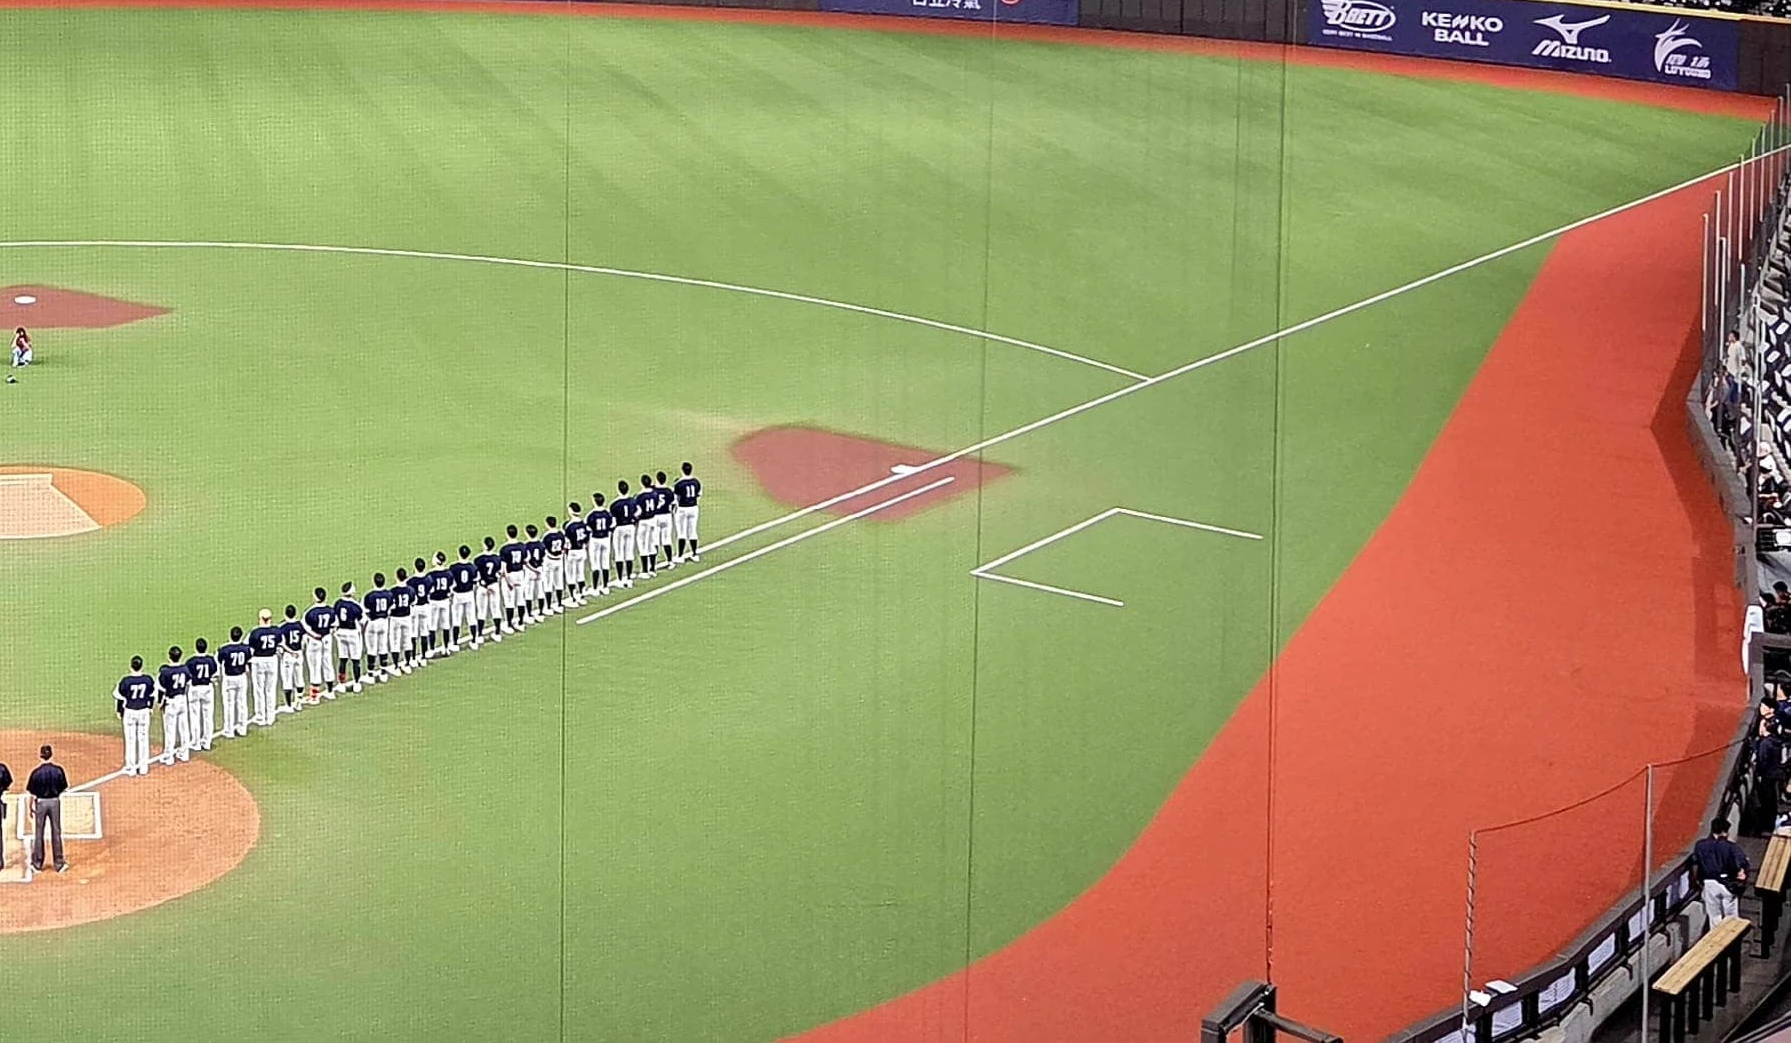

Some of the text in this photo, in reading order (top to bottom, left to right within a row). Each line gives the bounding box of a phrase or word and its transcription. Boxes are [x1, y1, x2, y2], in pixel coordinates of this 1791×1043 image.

[1421, 11, 1503, 33] KENKO
[1433, 28, 1489, 47] BALL
[1531, 39, 1611, 63] MIZUNO
[486, 562, 494, 574] 7
[318, 614, 329, 628] 17
[260, 635, 275, 649] 75
[289, 630, 300, 644] 15
[230, 652, 245, 667] 70
[196, 664, 209, 679] 71
[130, 684, 146, 699] 77
